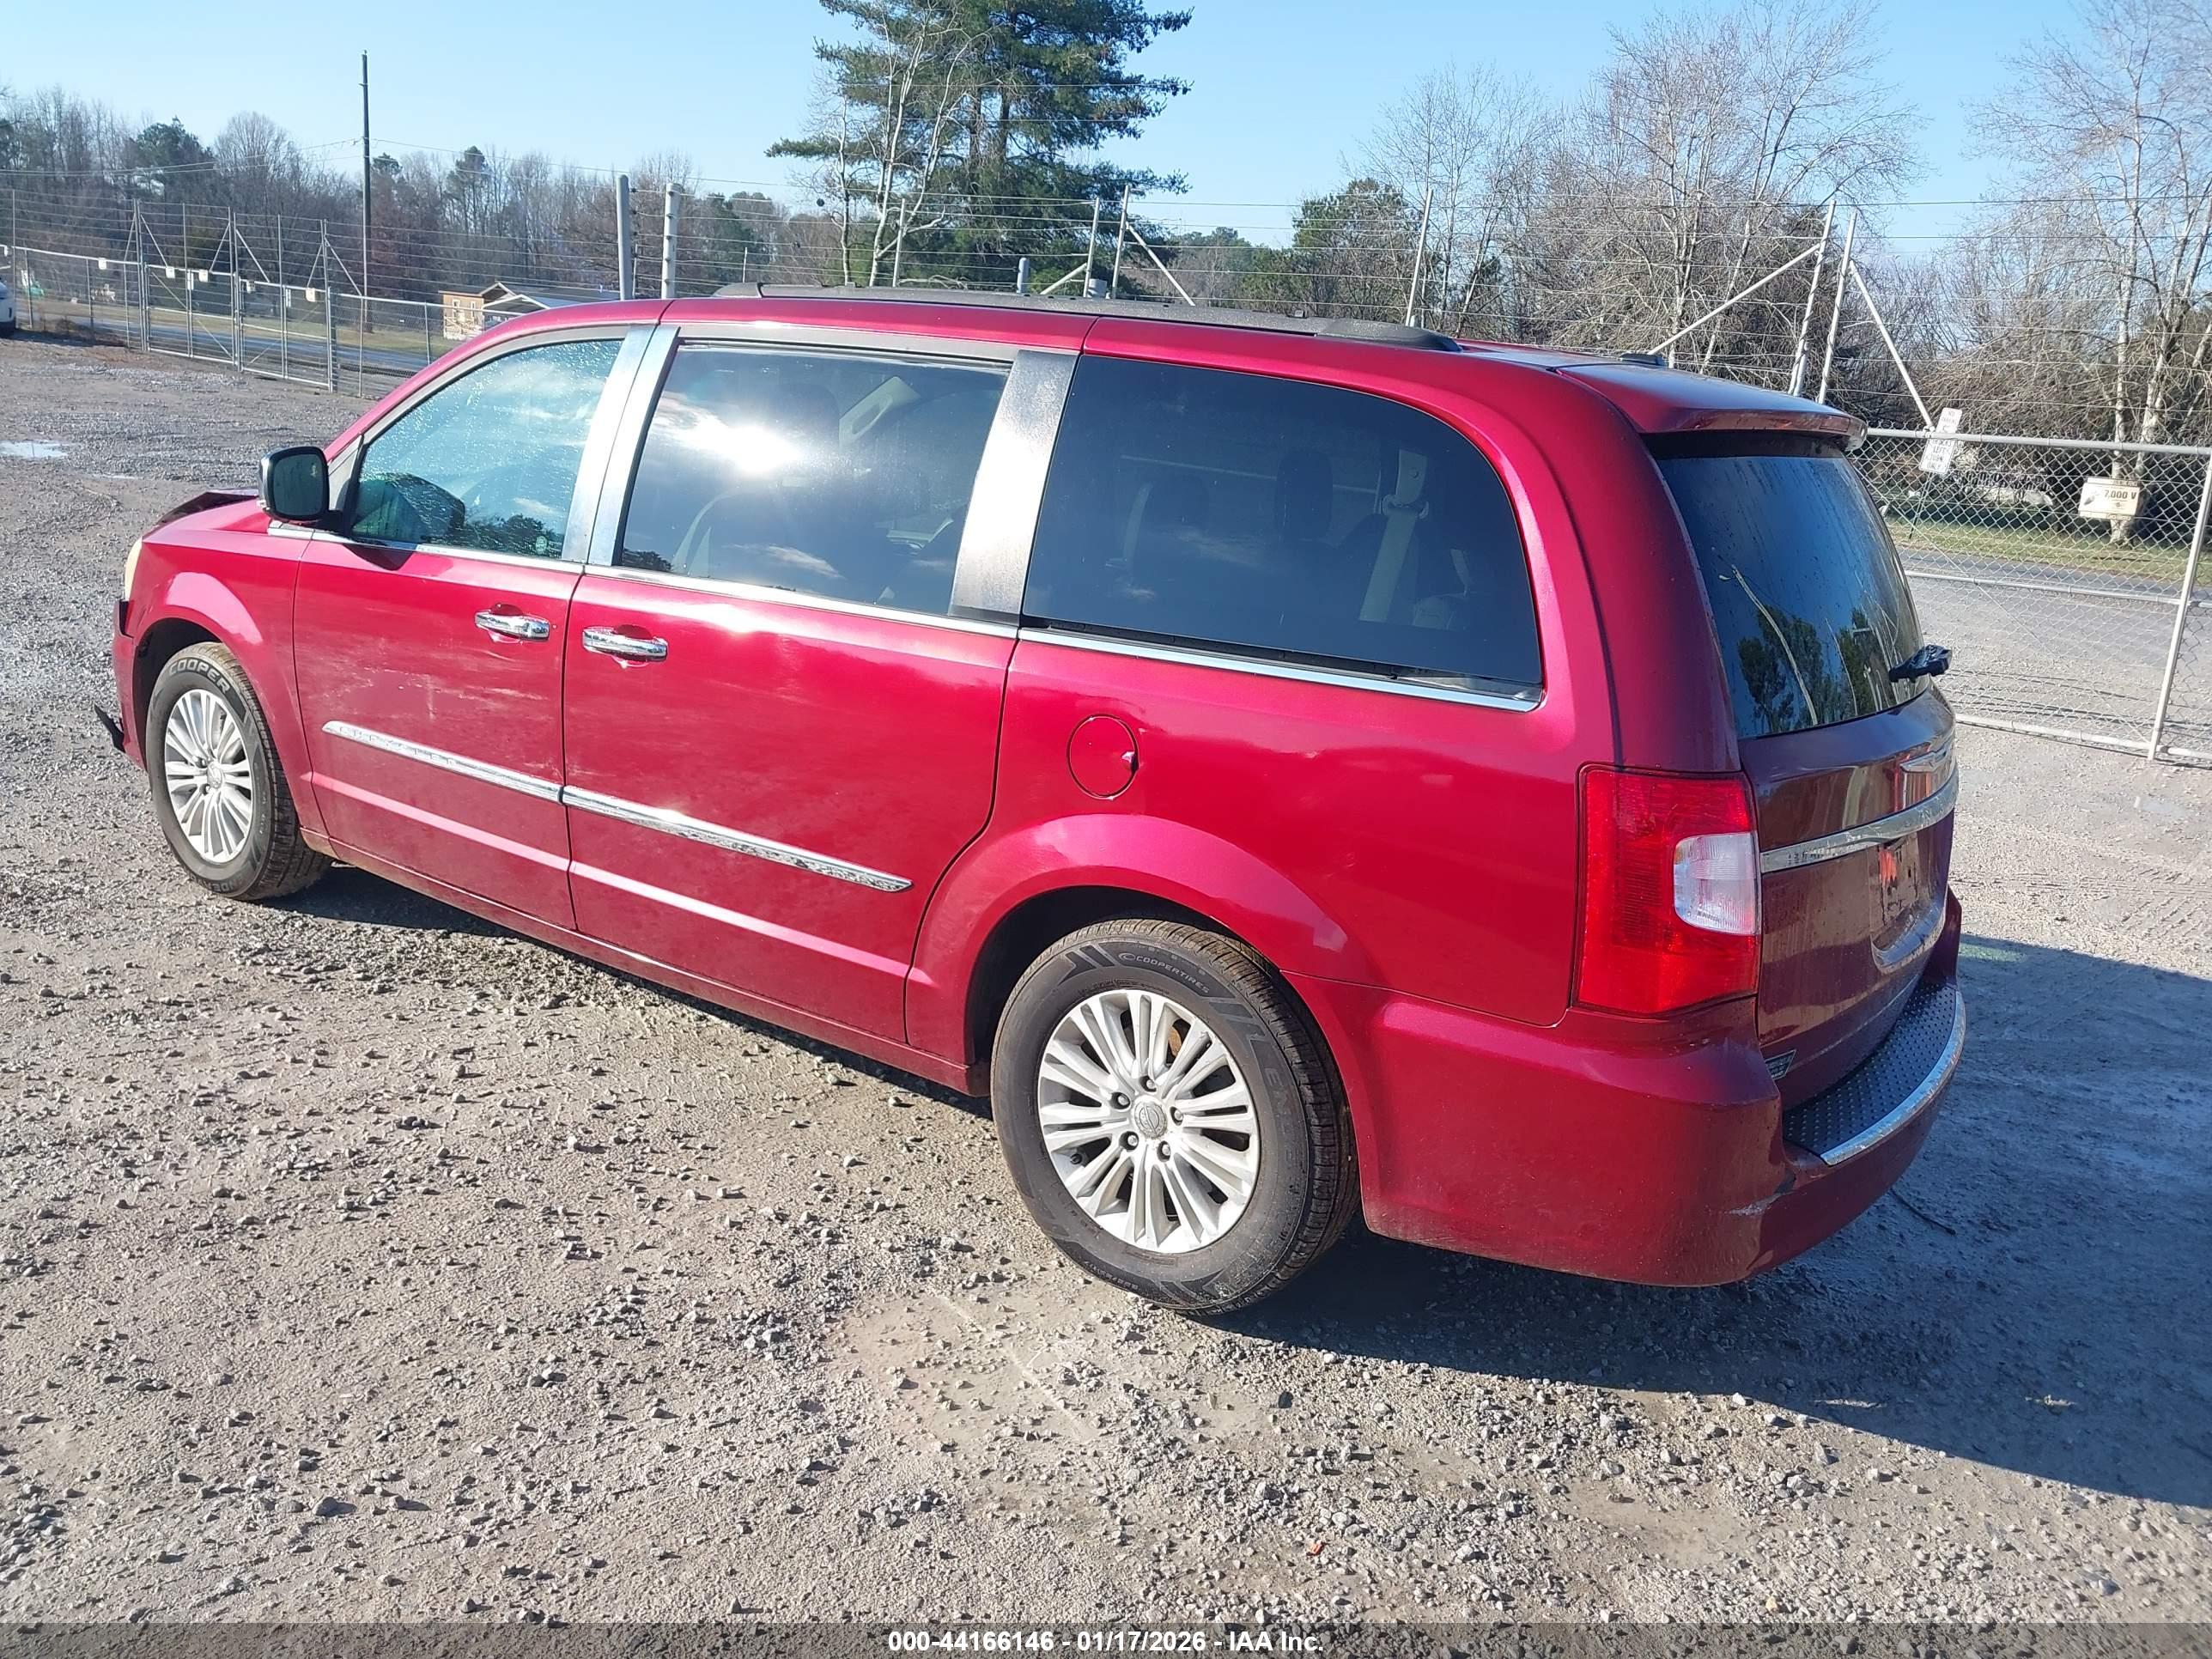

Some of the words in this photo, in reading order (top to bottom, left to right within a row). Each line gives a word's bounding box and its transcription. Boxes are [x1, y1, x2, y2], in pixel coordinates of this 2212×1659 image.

[2105, 489, 2129, 500] 7,000
[2130, 491, 2137, 500] V
[169, 659, 230, 694] COOPER
